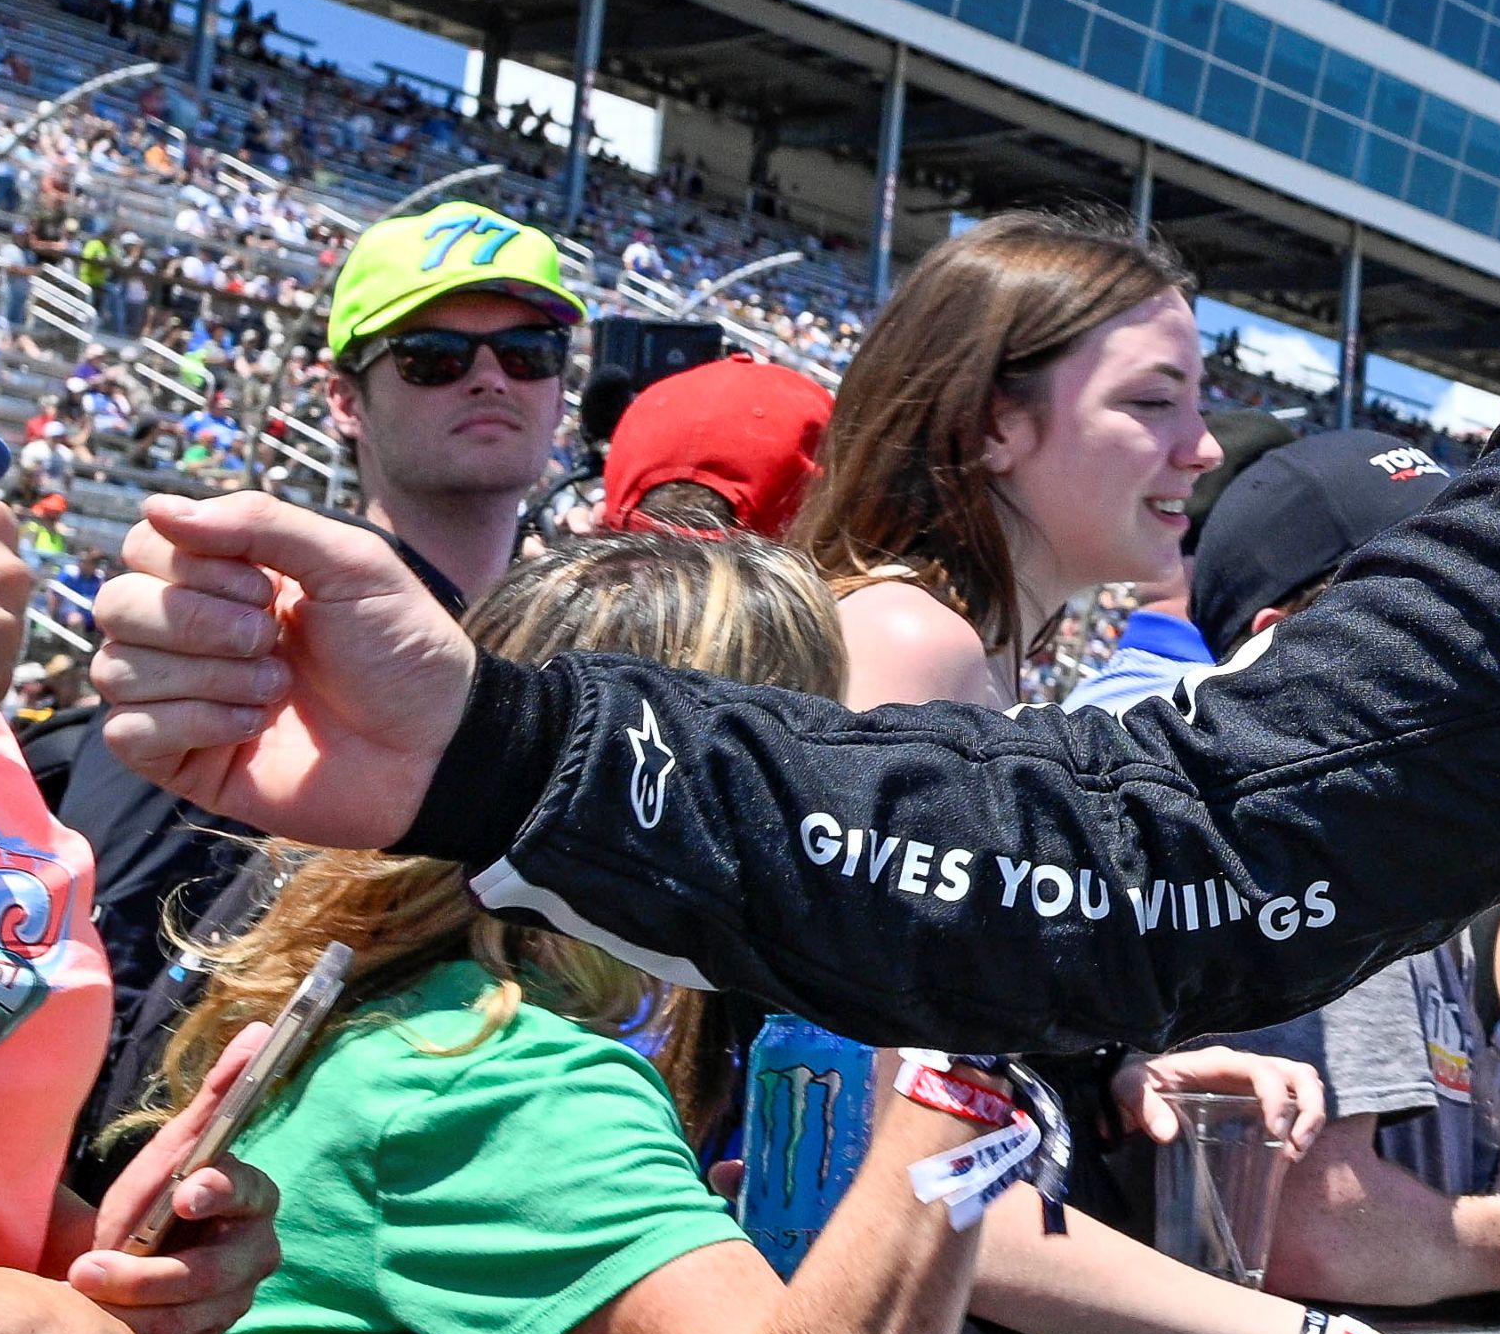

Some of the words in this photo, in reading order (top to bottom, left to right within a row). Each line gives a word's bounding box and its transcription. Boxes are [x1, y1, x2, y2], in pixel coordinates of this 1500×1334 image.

[420, 214, 522, 272] 77
[800, 812, 972, 903] GIVES
[996, 854, 1110, 920] YOU
